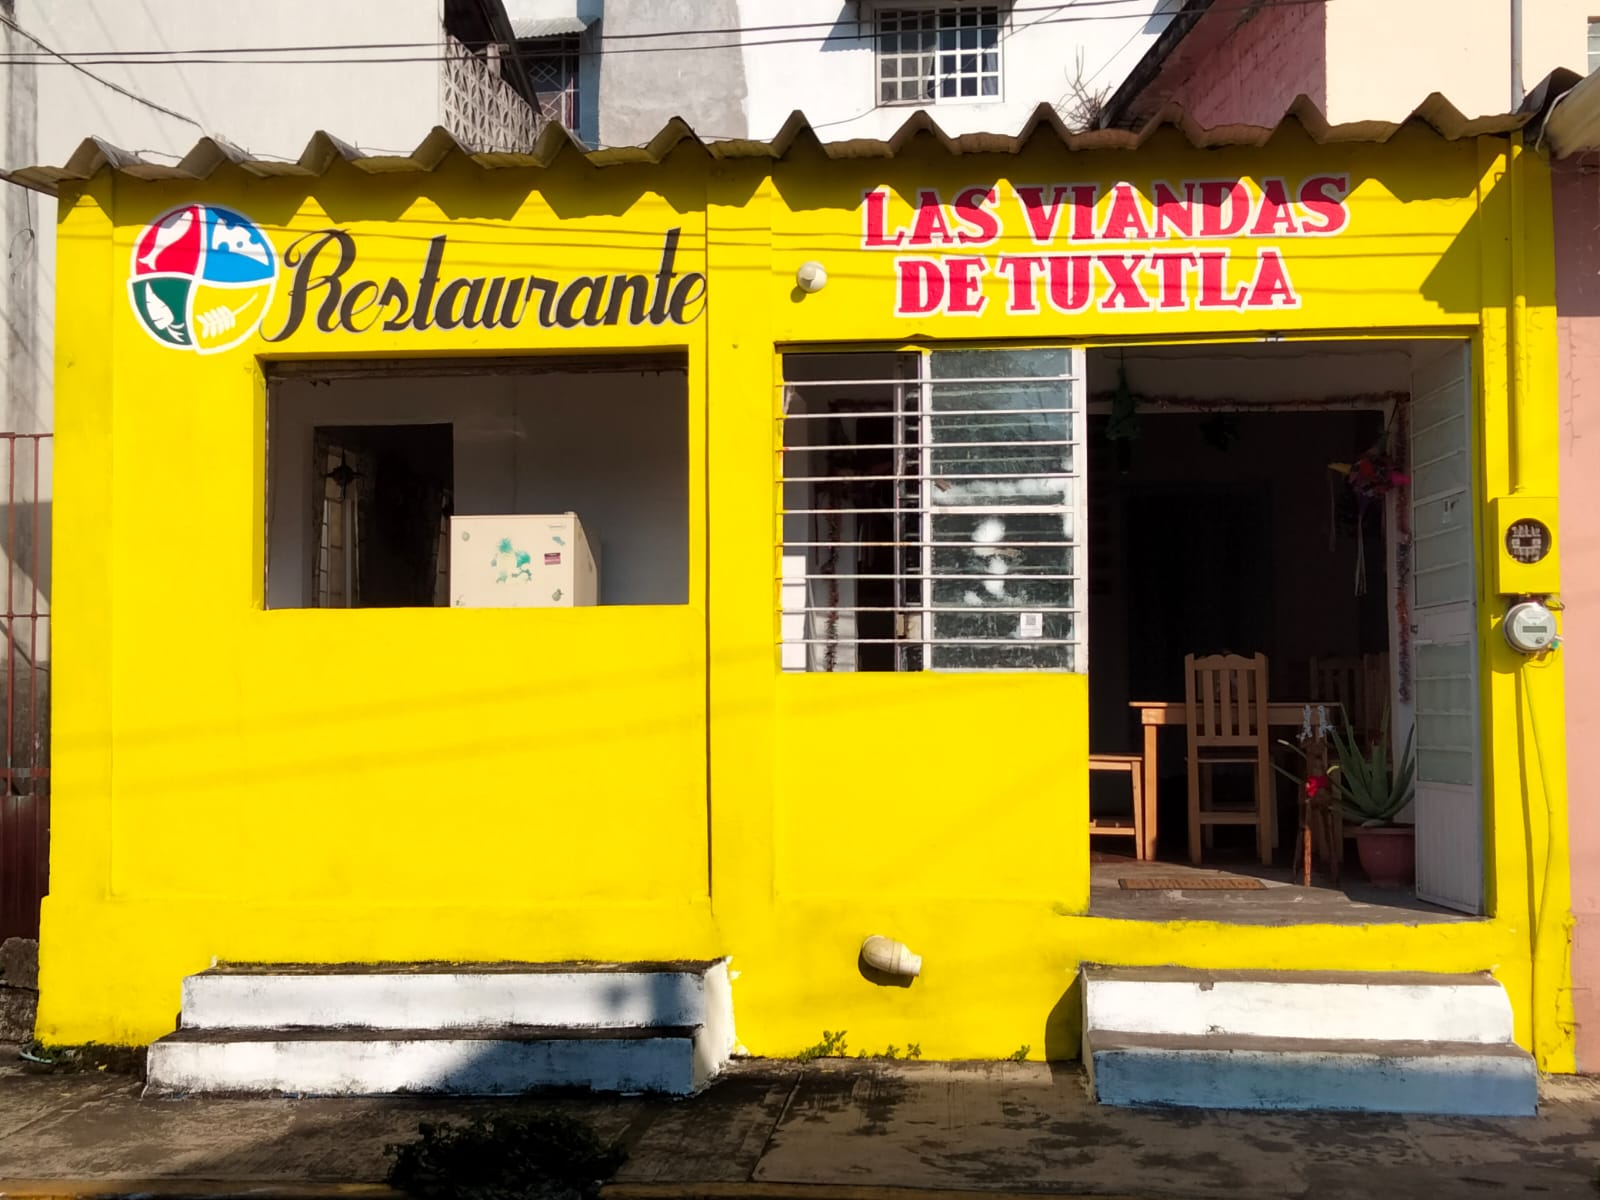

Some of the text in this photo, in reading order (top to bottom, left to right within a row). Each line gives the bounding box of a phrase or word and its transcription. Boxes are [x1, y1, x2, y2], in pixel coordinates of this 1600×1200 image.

[863, 176, 1349, 248] LAS VIANDAS
[260, 227, 707, 342] Restaurante
[897, 250, 1299, 315] DE TUXTLA
